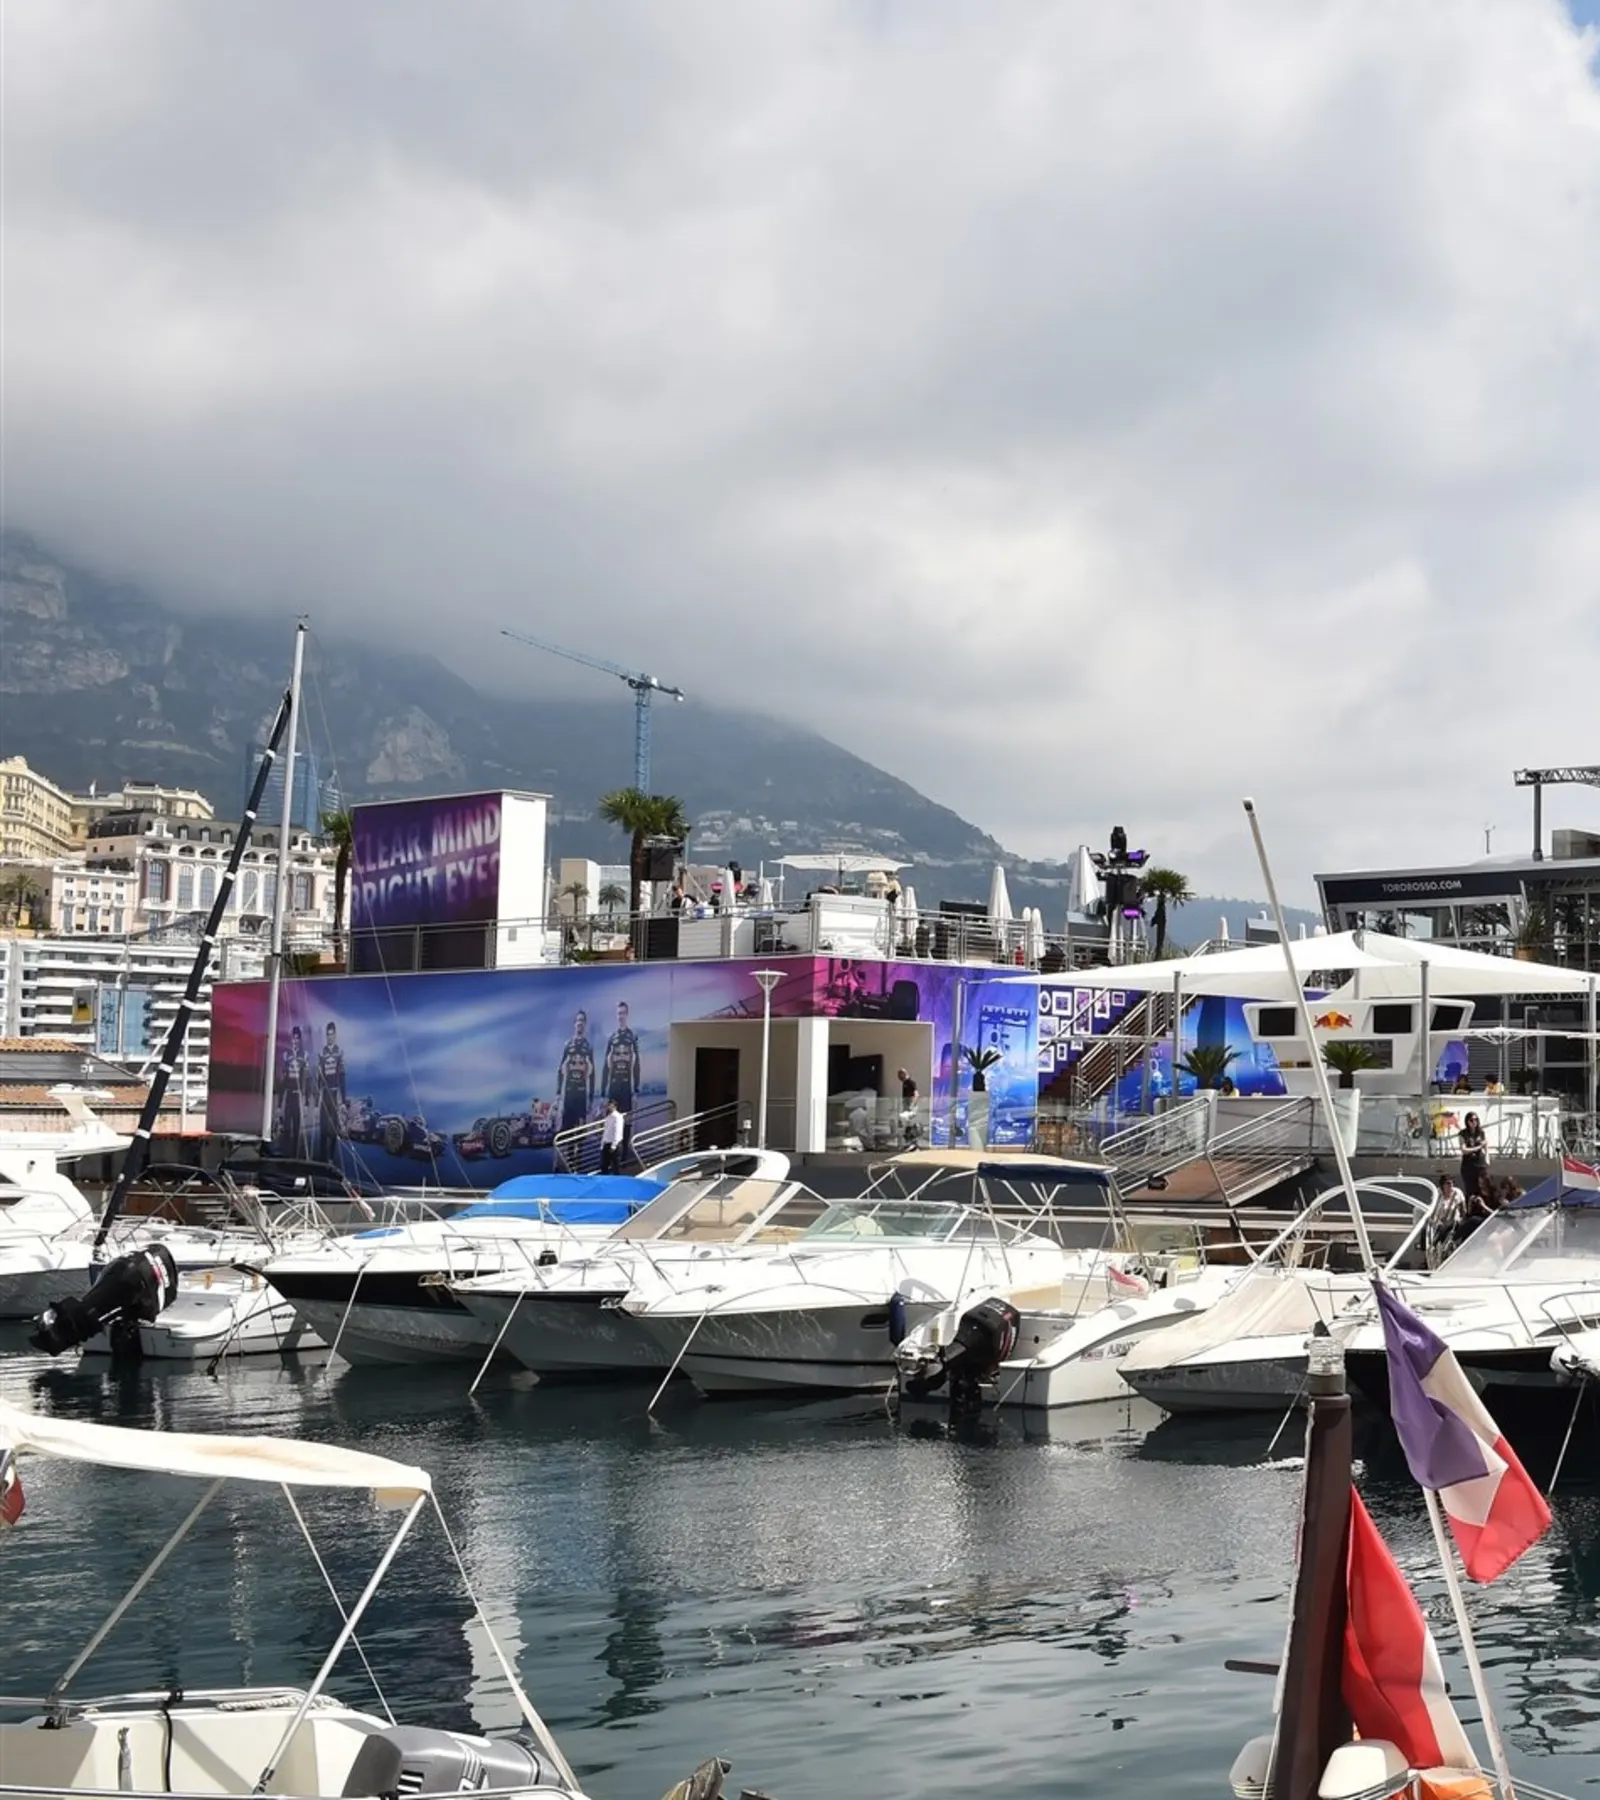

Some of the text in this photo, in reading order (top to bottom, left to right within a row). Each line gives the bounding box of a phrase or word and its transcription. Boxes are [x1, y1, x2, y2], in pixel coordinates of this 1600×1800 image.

[352, 803, 500, 875] CLEAR MIND
[351, 866, 438, 922] BRIGHT
[1381, 880, 1462, 893] TOROROSSO.COM
